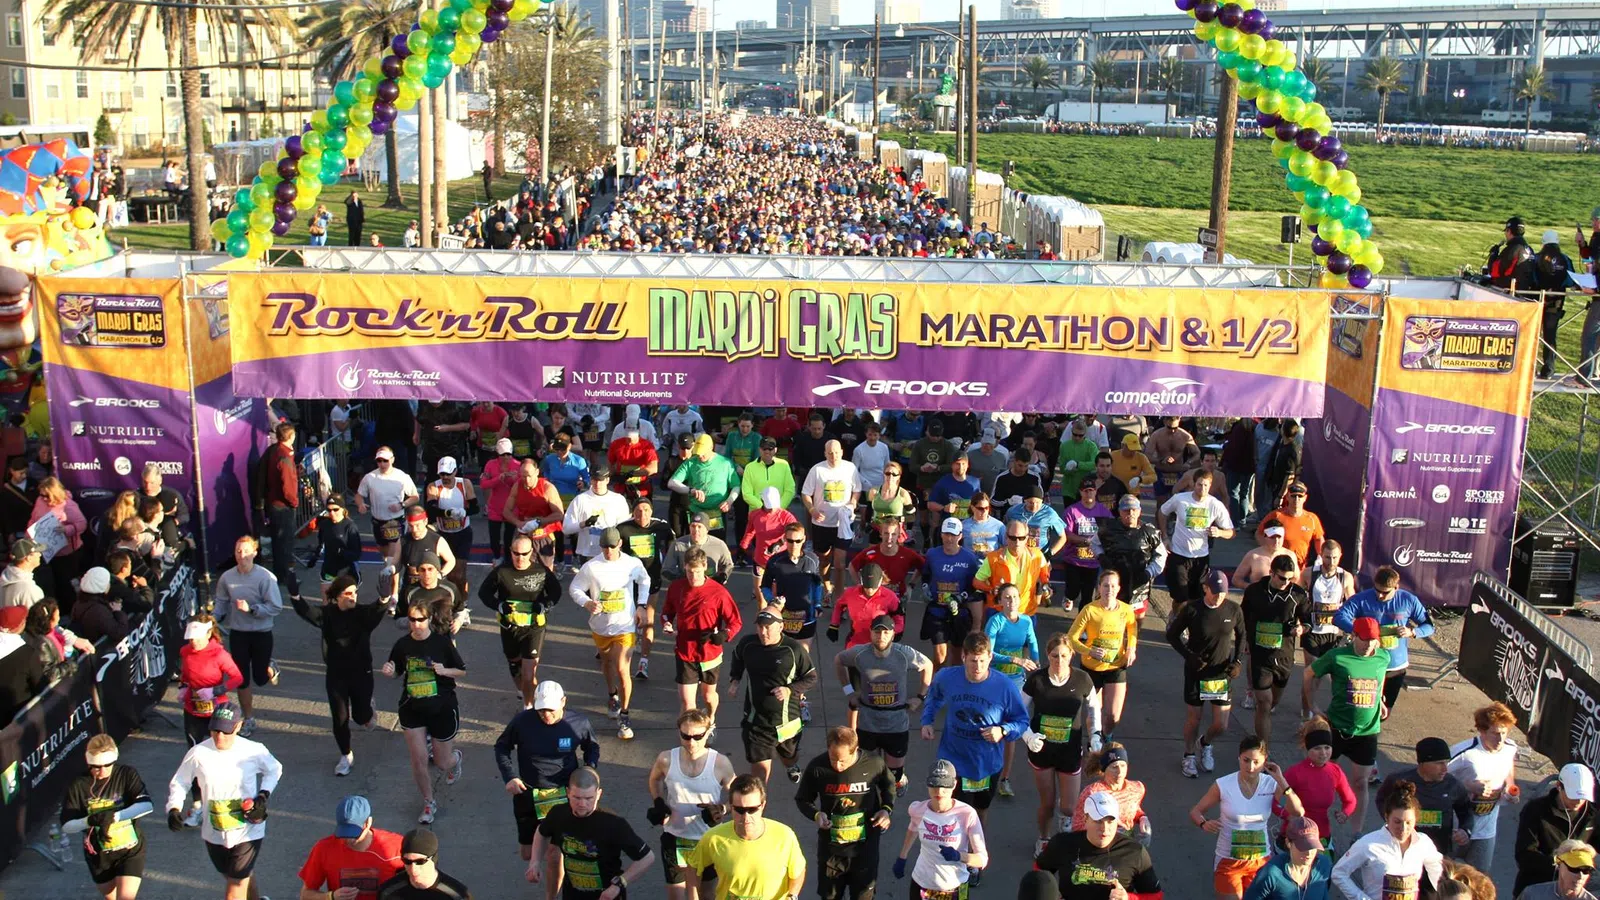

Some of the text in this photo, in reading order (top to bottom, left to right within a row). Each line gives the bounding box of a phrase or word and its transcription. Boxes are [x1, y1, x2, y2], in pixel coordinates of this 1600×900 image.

[133, 312, 163, 332] GRAS
[786, 288, 899, 364] GRAS
[917, 312, 1173, 351] MARATHON
[1180, 317, 1209, 347] &
[1221, 317, 1298, 357] 1/2
[150, 336, 164, 344] 1/2
[1483, 336, 1514, 356] GRAS
[1443, 360, 1488, 368] MARATHON
[1498, 360, 1512, 369] 1/2
[572, 371, 687, 386] NUTRILITE
[864, 379, 987, 398] BROOKS
[584, 389, 673, 400] Nutritional Supplements
[1105, 387, 1196, 406] competitor
[95, 397, 160, 408] BROOKS
[90, 426, 164, 437] NUTRILITE
[1425, 424, 1496, 435] BROOKS
[1412, 452, 1493, 464] NUTRILITE
[62, 461, 102, 471] GARMIN
[145, 461, 183, 470] ORTS
[1420, 465, 1482, 474] Nutritional Supplements
[1374, 489, 1417, 499] GARMIN
[1465, 489, 1505, 499] SPORTS
[1490, 610, 1538, 660] BROOKS
[873, 695, 895, 705] 3007
[1352, 693, 1372, 705] 3116
